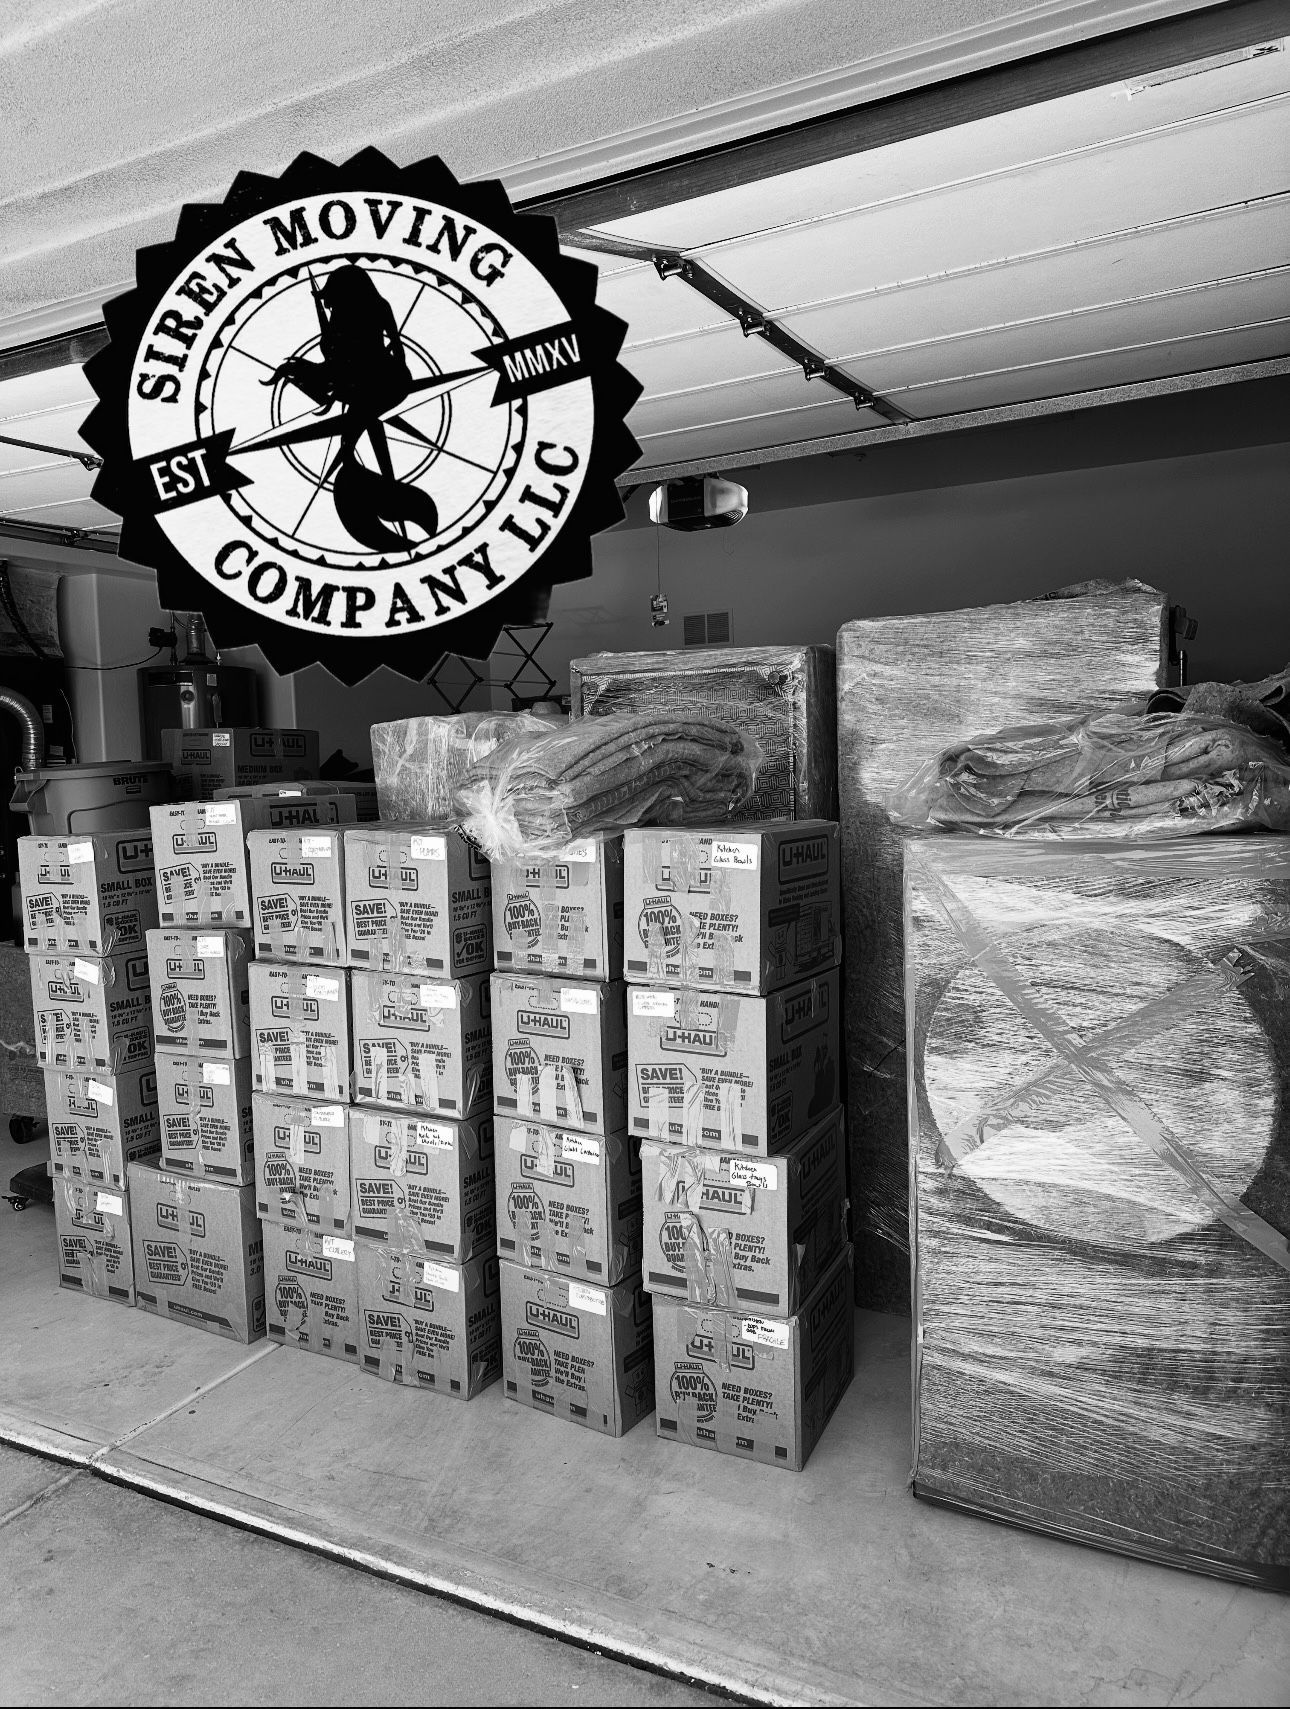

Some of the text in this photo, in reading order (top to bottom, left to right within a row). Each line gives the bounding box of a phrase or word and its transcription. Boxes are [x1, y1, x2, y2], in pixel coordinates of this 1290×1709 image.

[113, 775, 148, 786] BRUTE
[716, 845, 740, 854] Kitchen
[782, 841, 826, 867] U-HAUL
[733, 856, 753, 865] Bowls
[162, 867, 191, 882] SAVE!
[274, 866, 311, 876] U-HAUL
[101, 877, 152, 893] SMALL BOX
[28, 896, 53, 908] SAVE!
[452, 890, 481, 903] SMALL
[645, 897, 670, 906] U-HAUL
[261, 897, 288, 911] SAVE!
[355, 902, 386, 915] SAVE!
[461, 913, 469, 921] CU
[508, 903, 534, 920] 100%
[643, 909, 677, 925] 100%
[710, 913, 738, 923] BOXES?
[357, 920, 370, 928] BEST
[508, 918, 539, 932] BUY-BACK
[708, 923, 739, 932] PLENTY!
[465, 941, 483, 954] OK
[110, 999, 142, 1012] SMALL
[163, 993, 182, 1008] 100%
[521, 1014, 566, 1030] U-HAUL
[259, 1032, 289, 1043] SAVE!
[127, 1040, 148, 1053] OK
[509, 1050, 535, 1065] 100%
[544, 1054, 584, 1066] NEED BOXES?
[640, 1068, 684, 1081] SAVE!
[701, 1075, 716, 1083] SAVE
[734, 1079, 754, 1088] MORE!
[124, 1112, 155, 1128] SMALL
[166, 1117, 190, 1128] SAVE!
[55, 1126, 77, 1136] SAVE!
[143, 1130, 152, 1138] FT
[267, 1163, 290, 1176] 100%
[314, 1169, 333, 1178] BOXES?
[734, 1162, 757, 1172] Kitchen
[464, 1167, 490, 1189] SMALL
[732, 1172, 747, 1180] Glass
[360, 1183, 393, 1194] SAVE!
[420, 1192, 433, 1201] EVEN
[512, 1195, 539, 1210] 100%
[361, 1199, 395, 1208] BEST PRICE
[549, 1200, 589, 1215] NEED BOXES?
[549, 1209, 564, 1219] TAKE
[63, 1238, 86, 1249] SAVE!
[735, 1233, 765, 1245] BOXES?
[146, 1244, 177, 1258] SAVE!
[734, 1242, 765, 1255] PLENTY!
[201, 1258, 212, 1267] EVEN
[289, 1254, 329, 1273] U-HAUL
[734, 1253, 771, 1266] Buy Back
[149, 1262, 179, 1273] BEST PRICE
[279, 1286, 302, 1299] 100%
[310, 1291, 345, 1305] NEED BOXES?
[324, 1302, 346, 1313] PLENTY!
[325, 1311, 349, 1322] Buy Back
[368, 1314, 401, 1328] SAVE!
[468, 1304, 495, 1328] SMALL
[529, 1306, 576, 1329] U-HAUL
[385, 1332, 402, 1340] PRICE
[427, 1328, 439, 1336] EVEN
[440, 1332, 455, 1340] MORE!
[518, 1341, 544, 1357] 100%
[554, 1350, 594, 1367] NEED BOXES?
[554, 1359, 569, 1369] TAKE
[555, 1367, 583, 1383] We'll Buy
[555, 1376, 565, 1384] the
[675, 1375, 709, 1392] 100%
[722, 1382, 773, 1399] NEED BOXES?
[722, 1391, 773, 1409] TAKE PLENTY!
[742, 1406, 757, 1416] Buy
